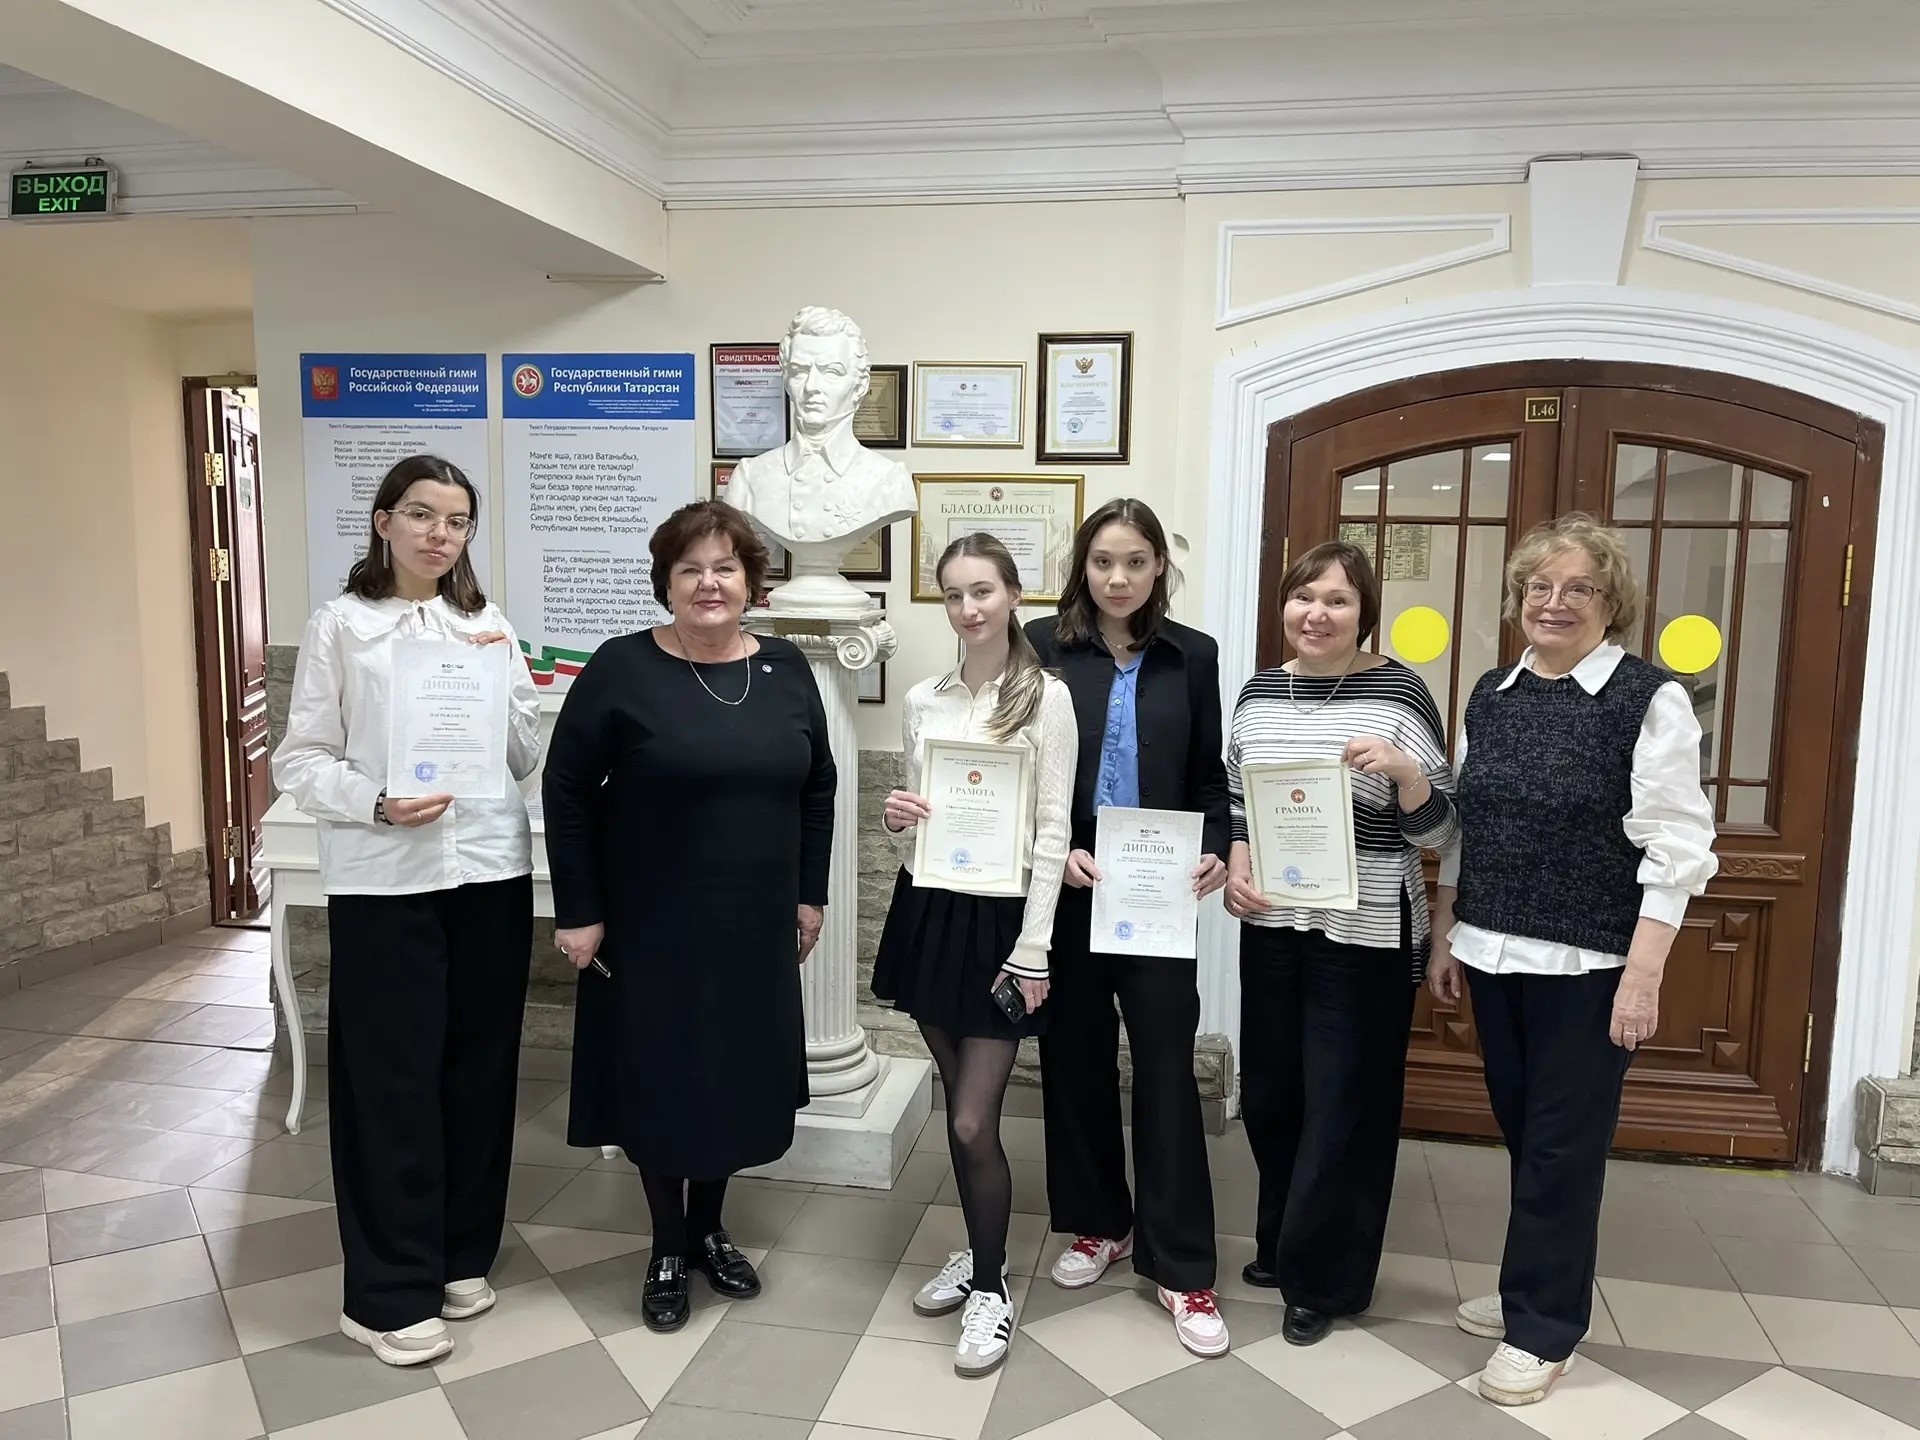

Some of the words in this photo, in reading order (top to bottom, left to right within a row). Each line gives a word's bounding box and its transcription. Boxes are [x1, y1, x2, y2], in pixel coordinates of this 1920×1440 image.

[17, 176, 104, 195] ВЫХОД
[39, 197, 80, 211] EXIT
[350, 367, 446, 380] Государственный
[449, 369, 477, 378] гимн
[551, 367, 650, 379] Государственный
[653, 369, 682, 378] гимн
[349, 382, 412, 393] Российской
[416, 382, 479, 394] Федерации
[554, 382, 620, 395] Республики
[624, 382, 680, 394] Татарстан
[1532, 404, 1554, 416] 1.46
[596, 453, 639, 462] Ватаныбыз,
[596, 474, 615, 482] туган
[618, 474, 641, 482] булып
[598, 505, 612, 513] бер
[941, 504, 1055, 515] БЛАГОДАРНОСТЬ
[602, 516, 648, 524] язмышыбыз,
[531, 524, 578, 533] Республикам
[608, 526, 648, 534] Татарстан!
[543, 555, 568, 564] Цвети,
[543, 565, 553, 574] Да
[555, 565, 576, 574] будет
[544, 576, 571, 584] Единый
[544, 596, 574, 604] Богатый
[618, 598, 640, 606] седых
[544, 606, 583, 615] Надеждой,
[586, 608, 609, 616] верою
[552, 617, 572, 625] пусть
[574, 617, 599, 625] хранит
[561, 627, 605, 636] Республика,
[422, 680, 480, 691] ДИПЛОМ
[949, 786, 995, 797] ГРАМОТА
[1275, 806, 1322, 814] ГРАМОТА
[1122, 844, 1174, 854] ДИПЛОМ
